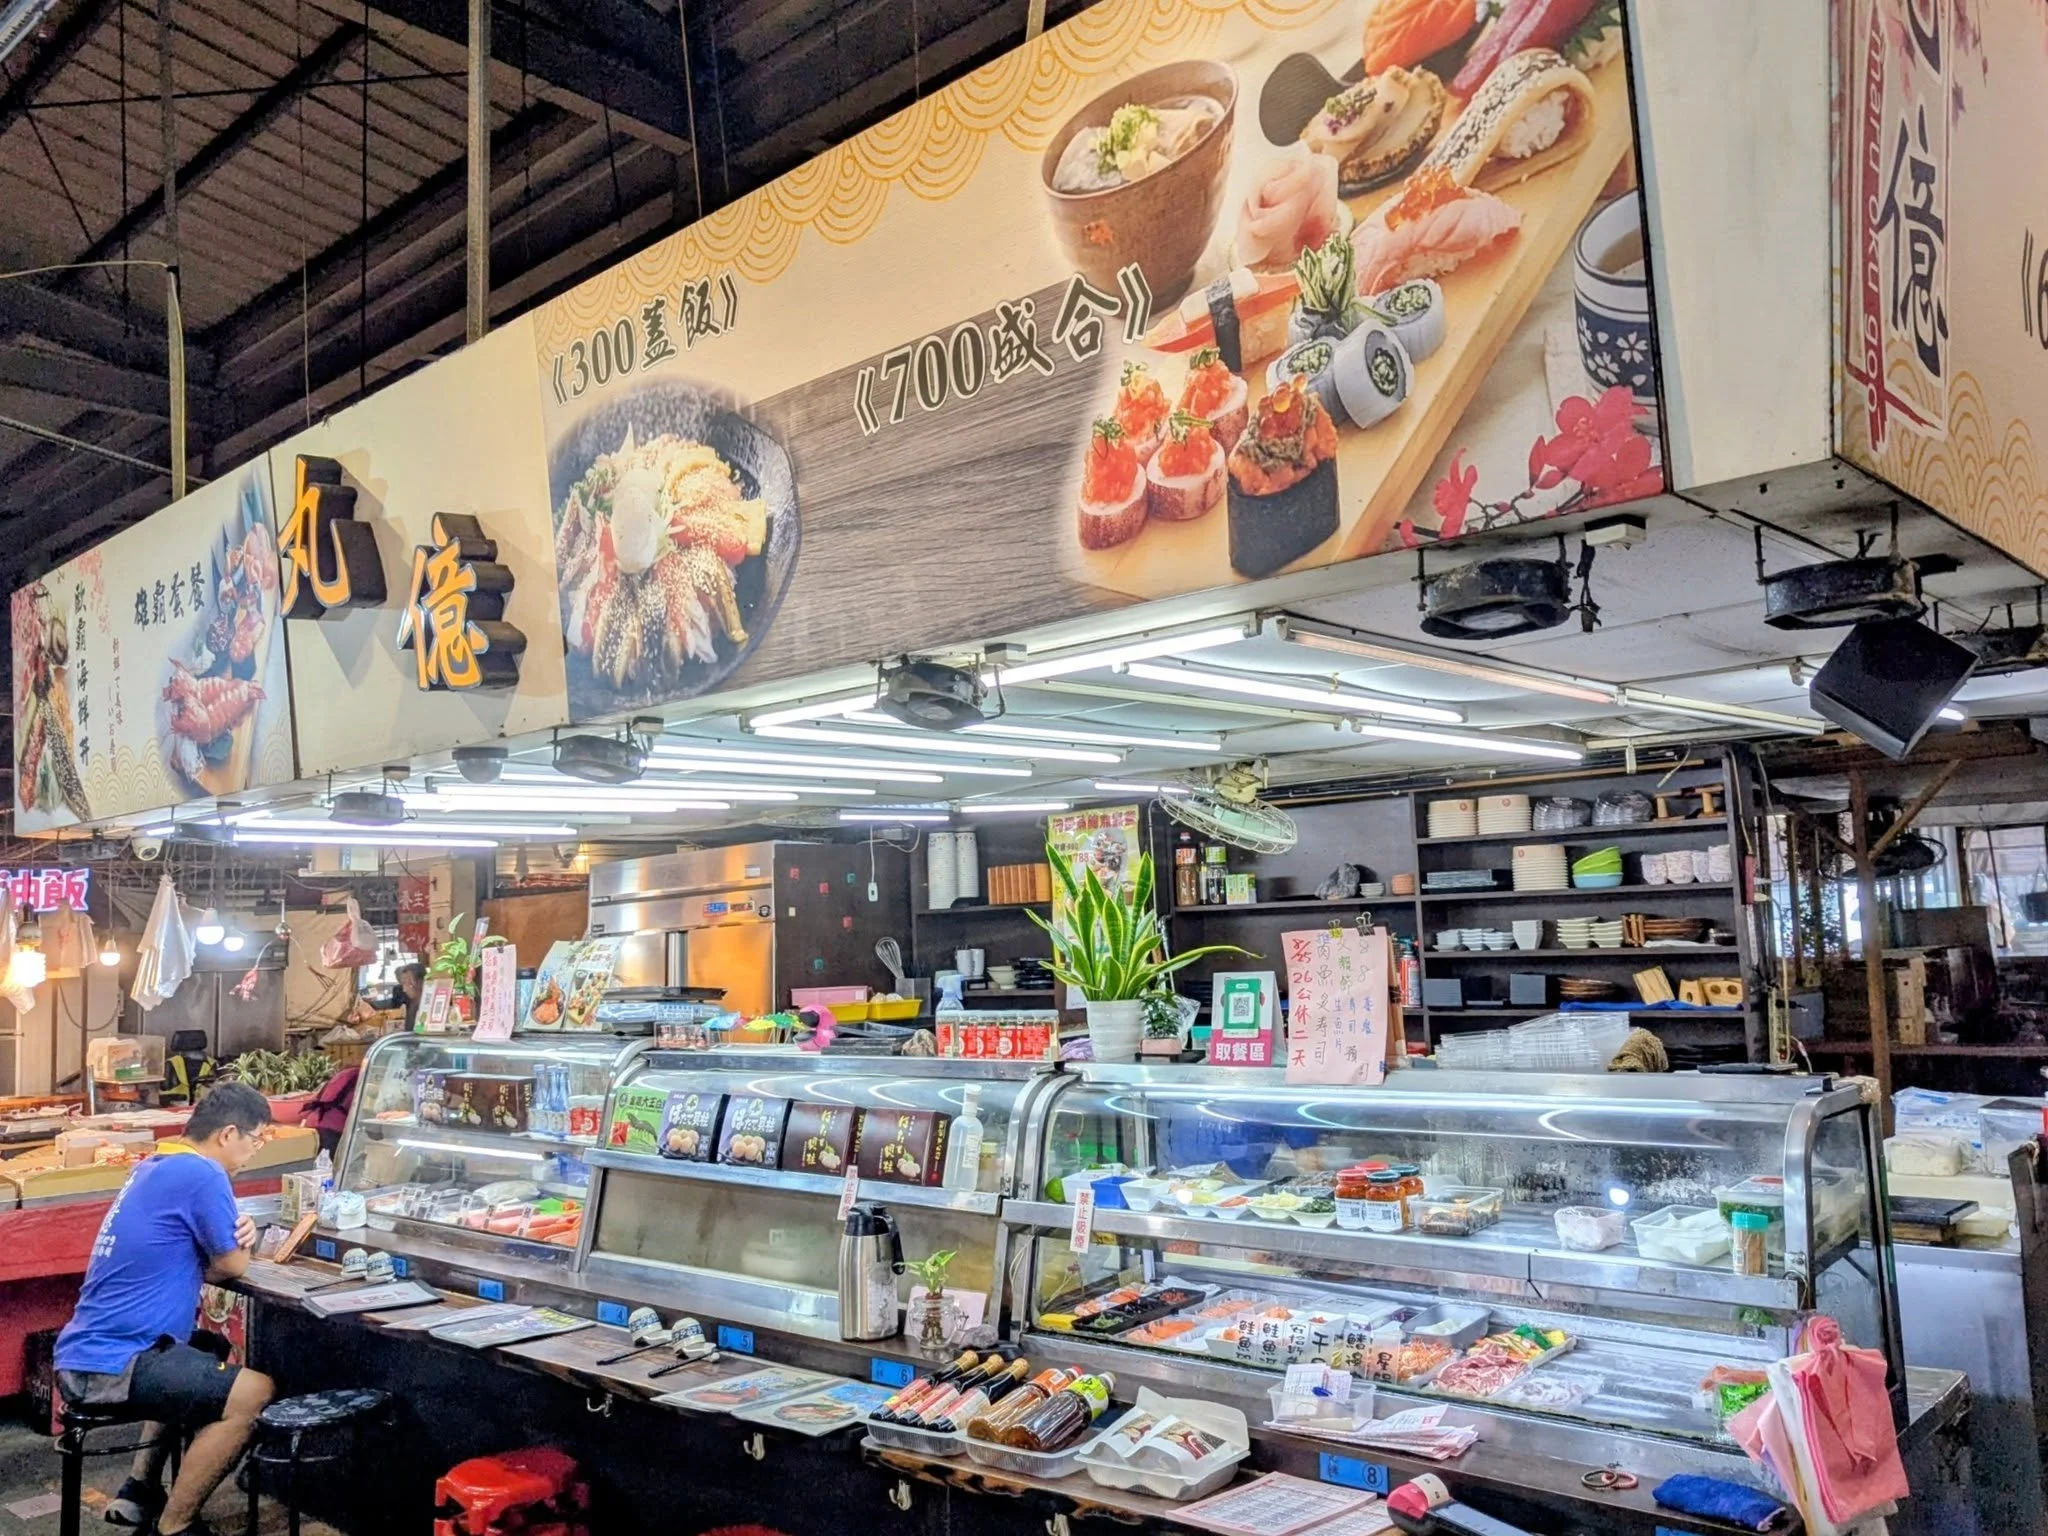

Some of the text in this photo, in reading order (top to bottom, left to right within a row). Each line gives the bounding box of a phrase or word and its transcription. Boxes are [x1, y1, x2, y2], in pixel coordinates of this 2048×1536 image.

[1864, 28, 1884, 414] maru oku goo
[1215, 1042, 1265, 1061] 取餐區
[1311, 1331, 1329, 1364] 干
